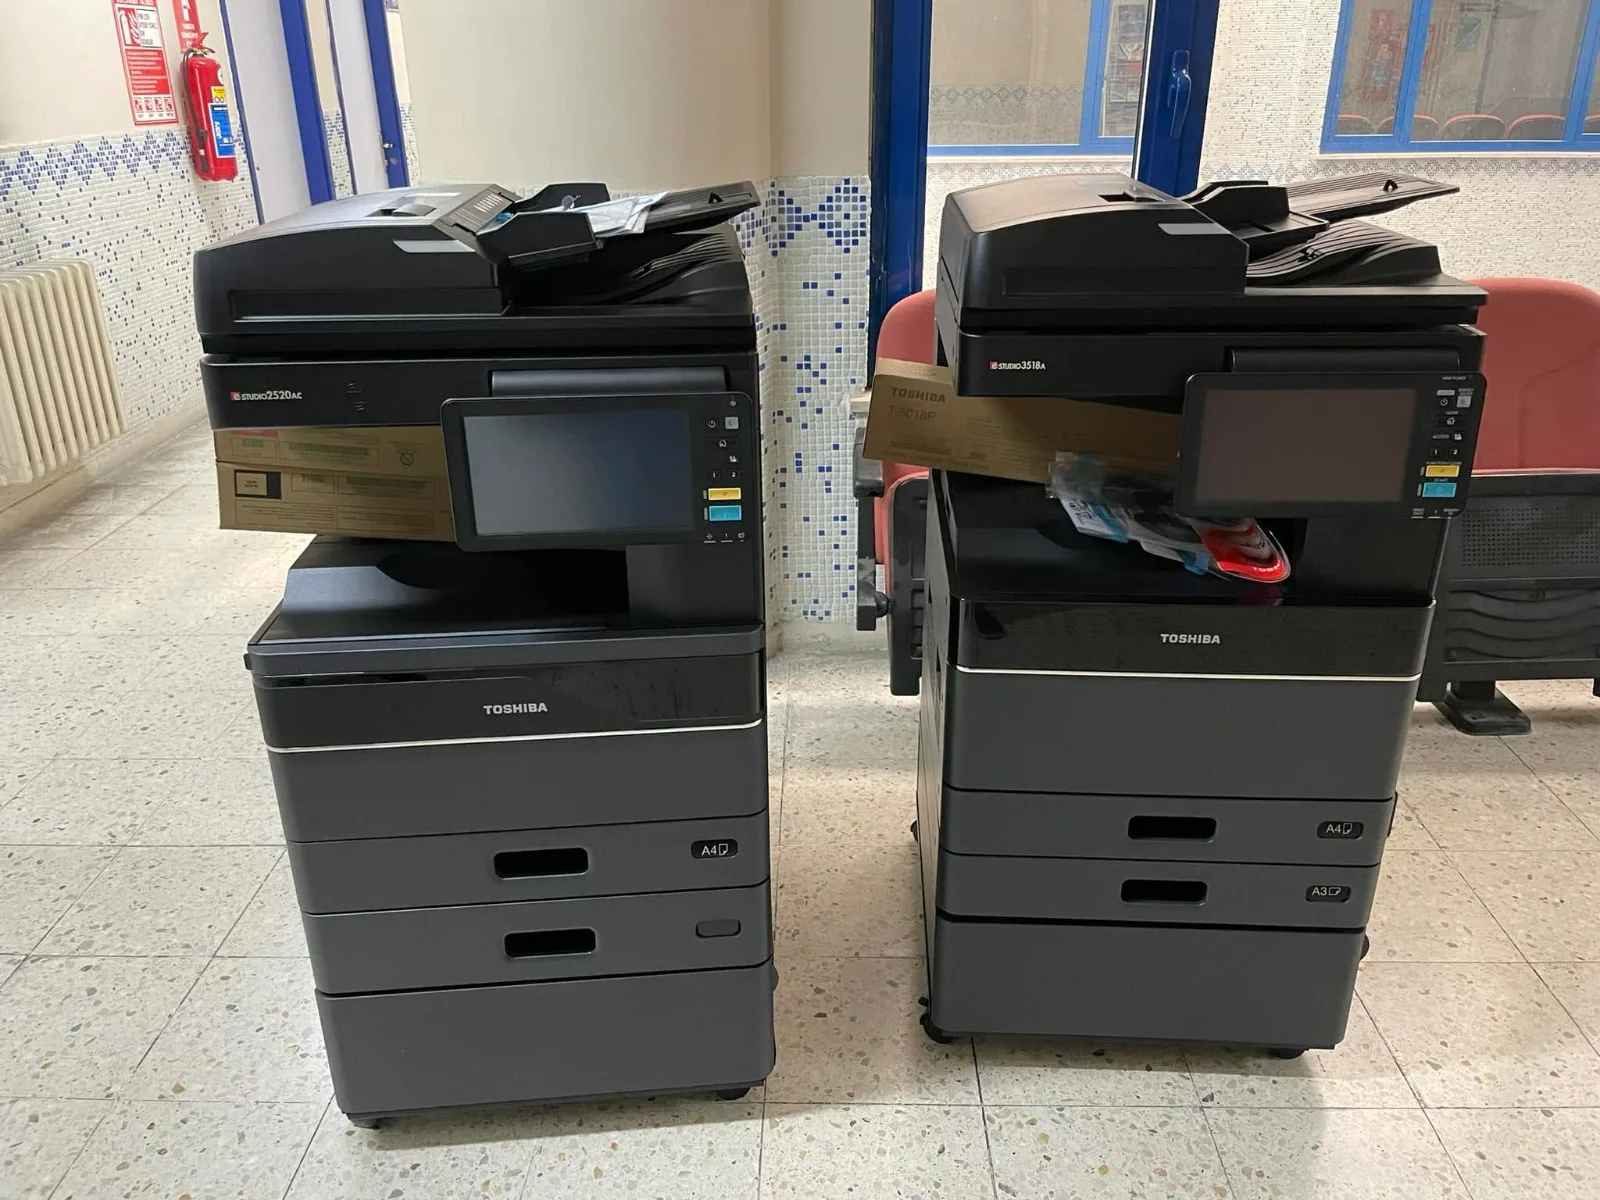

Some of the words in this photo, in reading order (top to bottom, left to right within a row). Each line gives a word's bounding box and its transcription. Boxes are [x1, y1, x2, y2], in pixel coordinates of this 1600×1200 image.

[890, 386, 945, 403] TOSHIBA
[1160, 633, 1221, 645] TOSHIBA
[483, 702, 548, 715] TOSHIBA
[1325, 824, 1342, 834] A4
[701, 844, 717, 856] A4
[1311, 886, 1328, 897] A3
